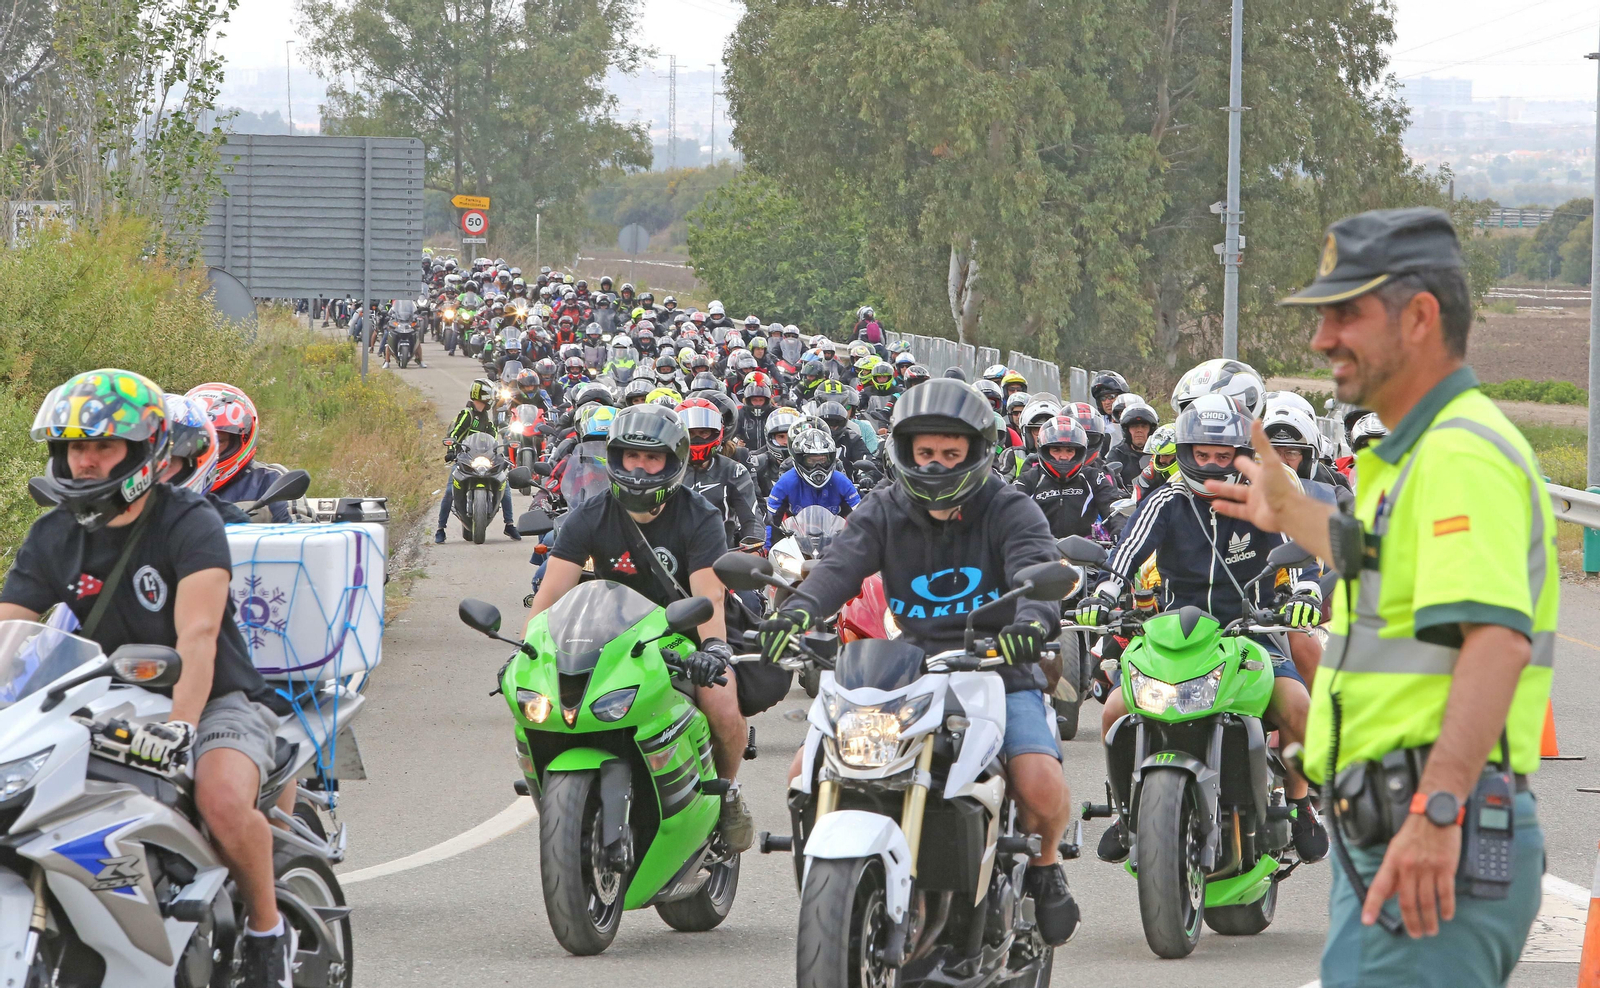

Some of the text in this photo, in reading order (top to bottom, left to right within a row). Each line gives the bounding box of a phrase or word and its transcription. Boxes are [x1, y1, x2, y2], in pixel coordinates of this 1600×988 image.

[467, 217, 482, 227] 50
[1201, 412, 1226, 421] SHOEI
[1225, 550, 1257, 565] adidas
[890, 588, 1001, 619] OAKLEY
